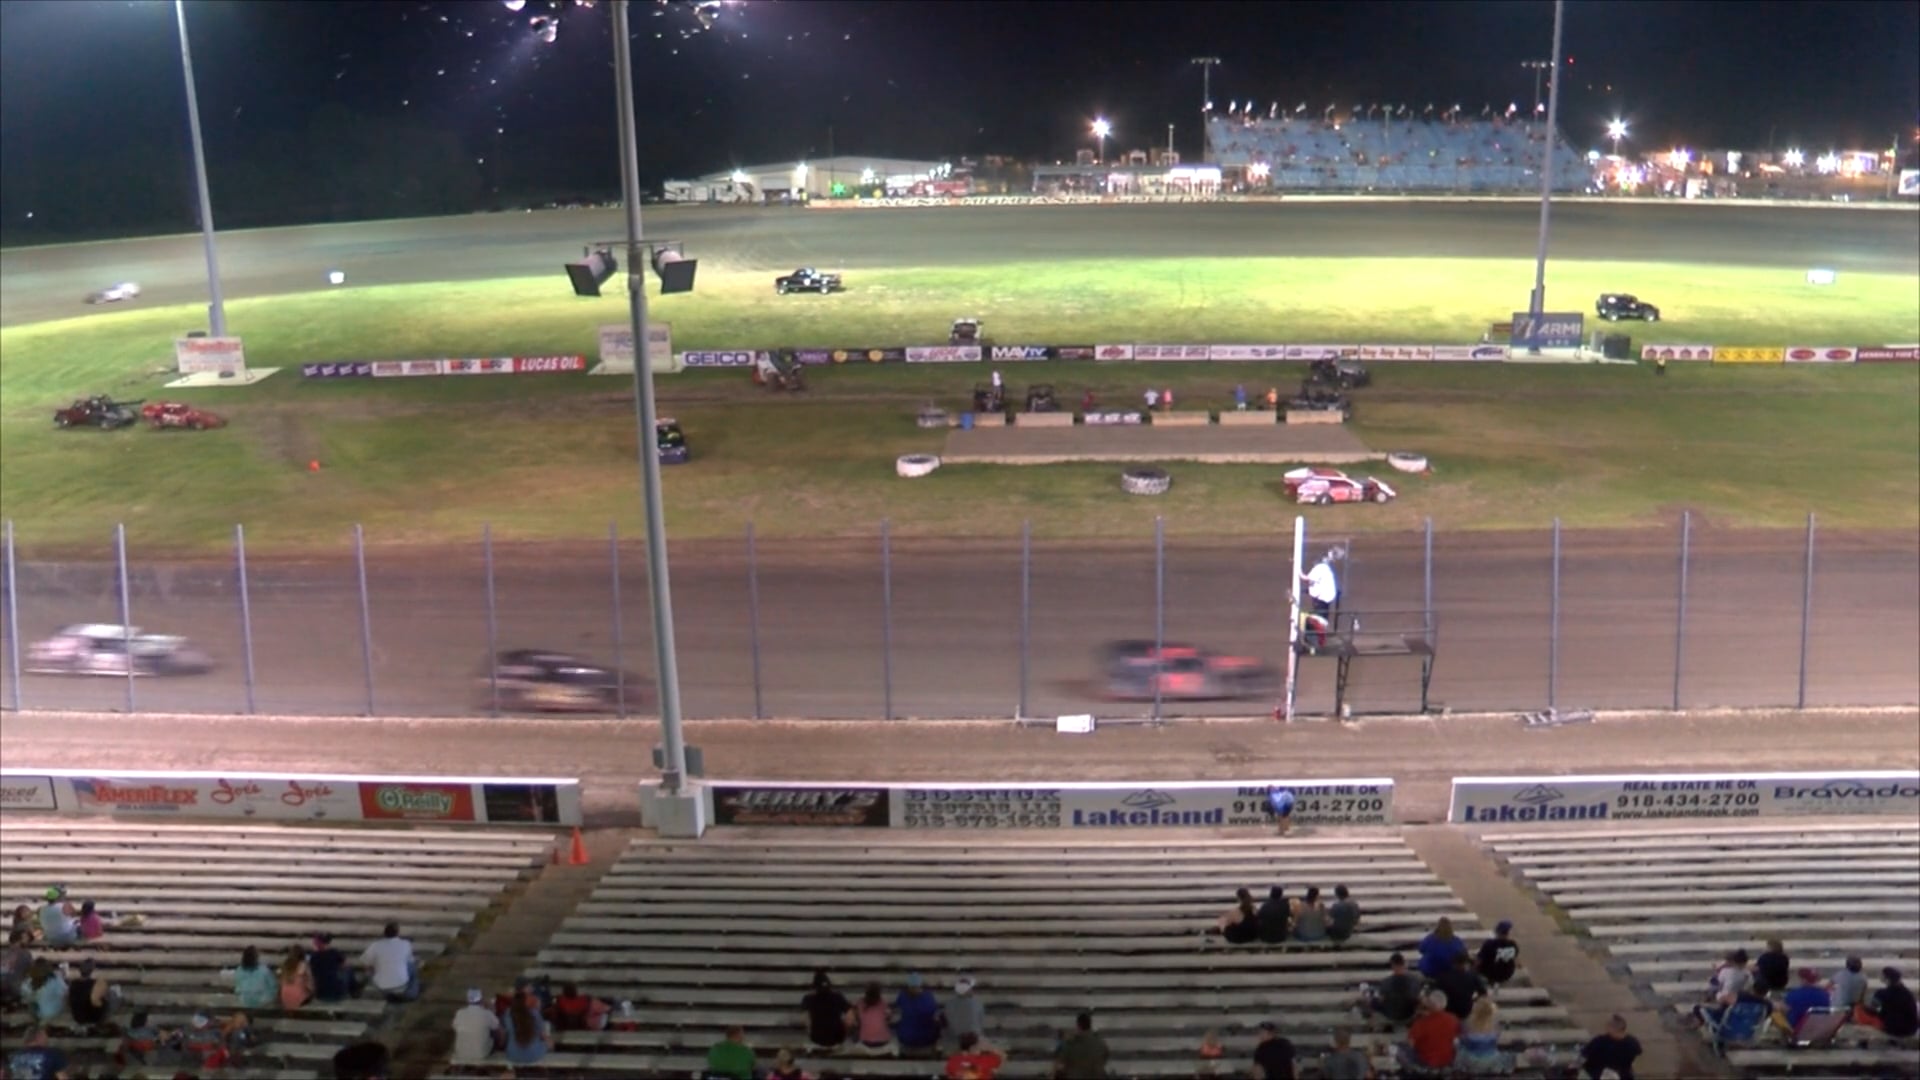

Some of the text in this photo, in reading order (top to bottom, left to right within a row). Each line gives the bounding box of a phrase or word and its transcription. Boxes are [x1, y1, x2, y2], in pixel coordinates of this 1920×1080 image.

[520, 358, 557, 370] LUCAS
[559, 356, 579, 369] OIL
[685, 352, 751, 364] GEICO
[1335, 786, 1354, 795] NE
[1359, 785, 1378, 795] OK
[1623, 780, 1757, 792] REAL ESTATE NE OK
[1233, 799, 1383, 813] 91834-2700
[1617, 794, 1760, 807] 918-434-2700
[1073, 808, 1223, 826] Lakeland
[1464, 802, 1608, 822] Lakeland
